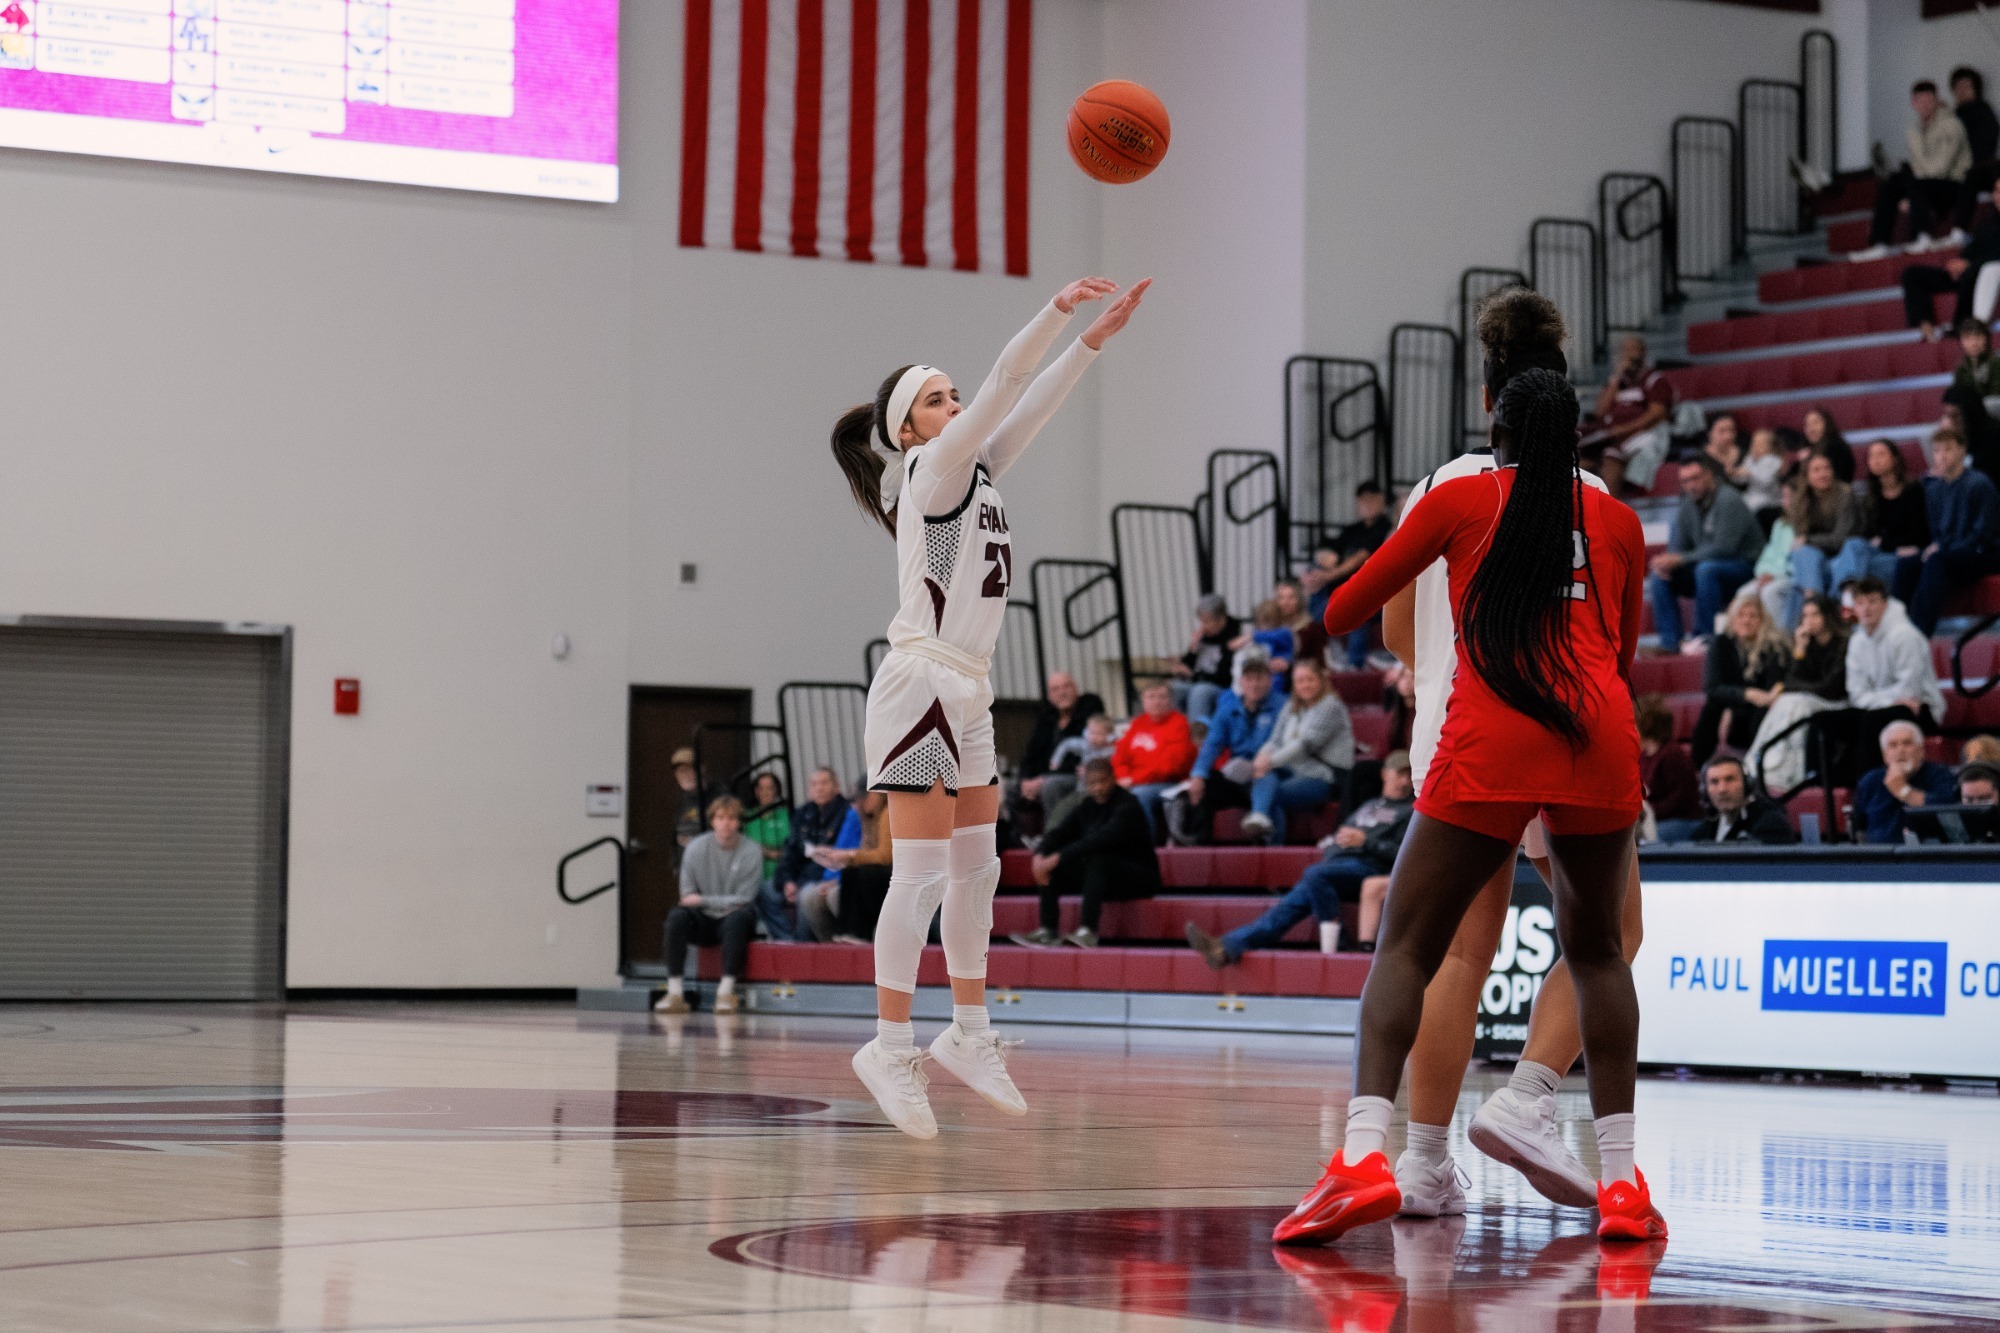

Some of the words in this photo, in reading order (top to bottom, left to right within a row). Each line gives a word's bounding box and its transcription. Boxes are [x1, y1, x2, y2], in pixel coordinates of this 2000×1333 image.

[1099, 122, 1154, 157] LEGACY
[1669, 956, 1749, 992] PAUL
[1772, 956, 1934, 998] MUELLER
